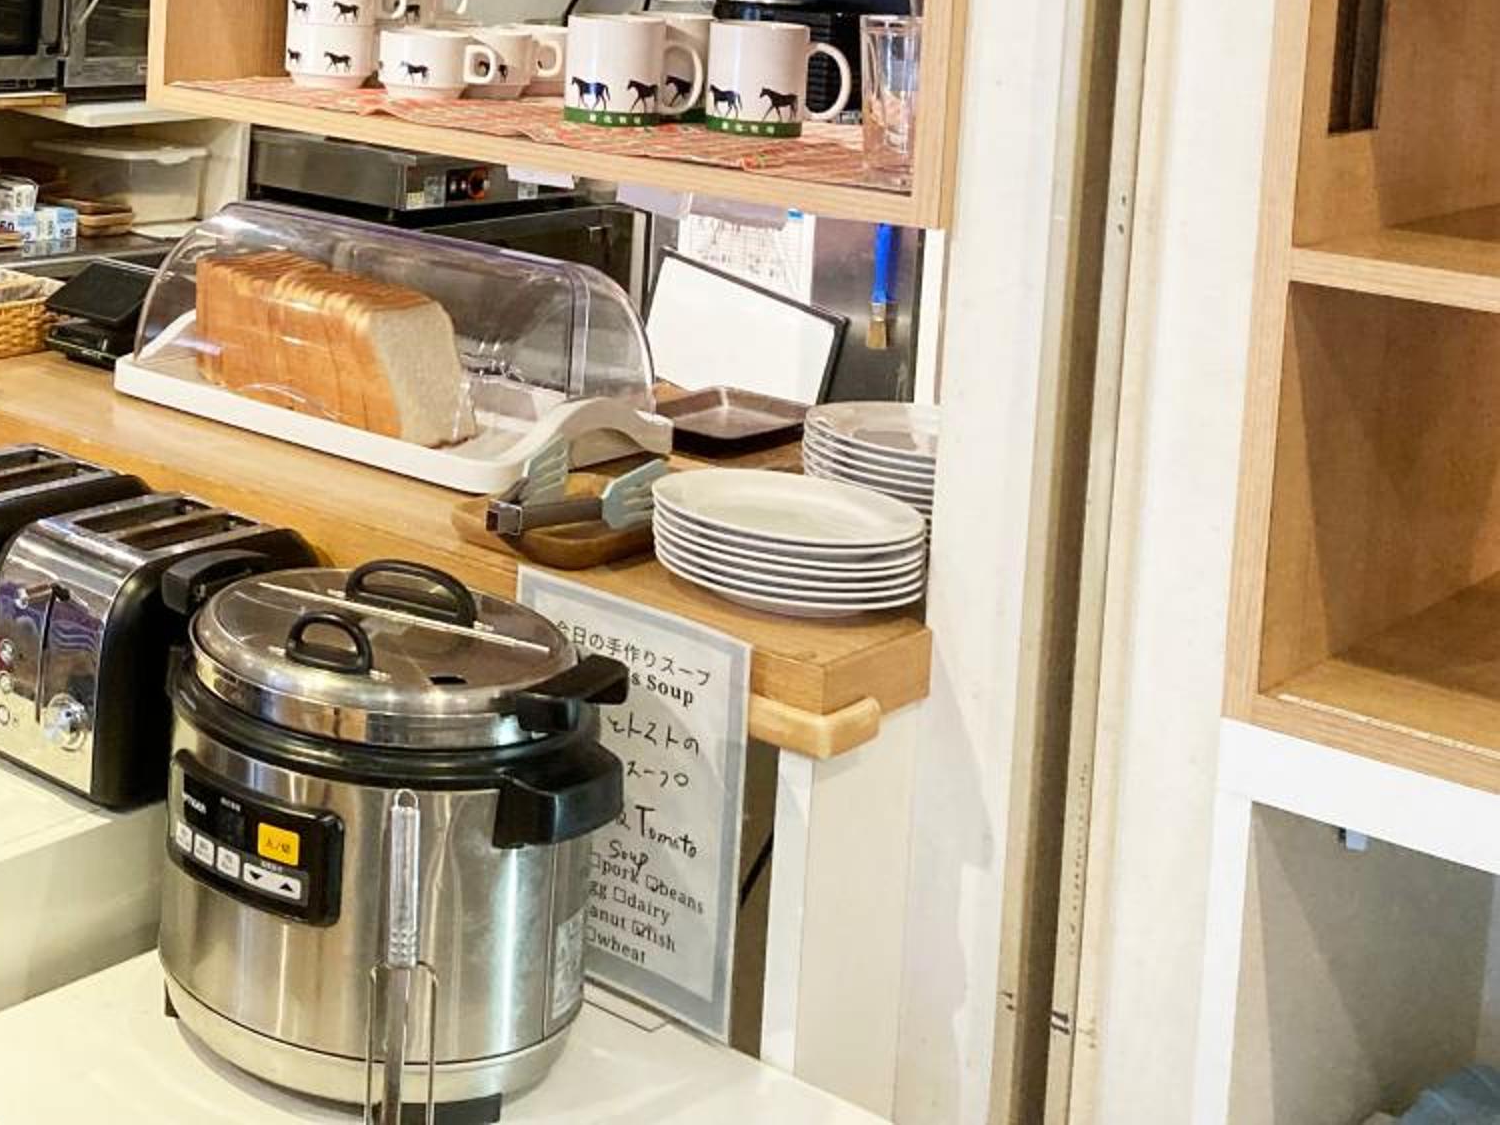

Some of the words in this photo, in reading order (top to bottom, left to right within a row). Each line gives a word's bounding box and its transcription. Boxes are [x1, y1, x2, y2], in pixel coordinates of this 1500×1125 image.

[646, 674, 693, 708] Soup
[608, 839, 650, 876] Soup
[587, 880, 609, 901] gg
[627, 895, 672, 925] dairy
[601, 860, 640, 885] pork
[659, 878, 705, 915] beans
[584, 903, 628, 931] anut
[596, 931, 647, 965] wheat
